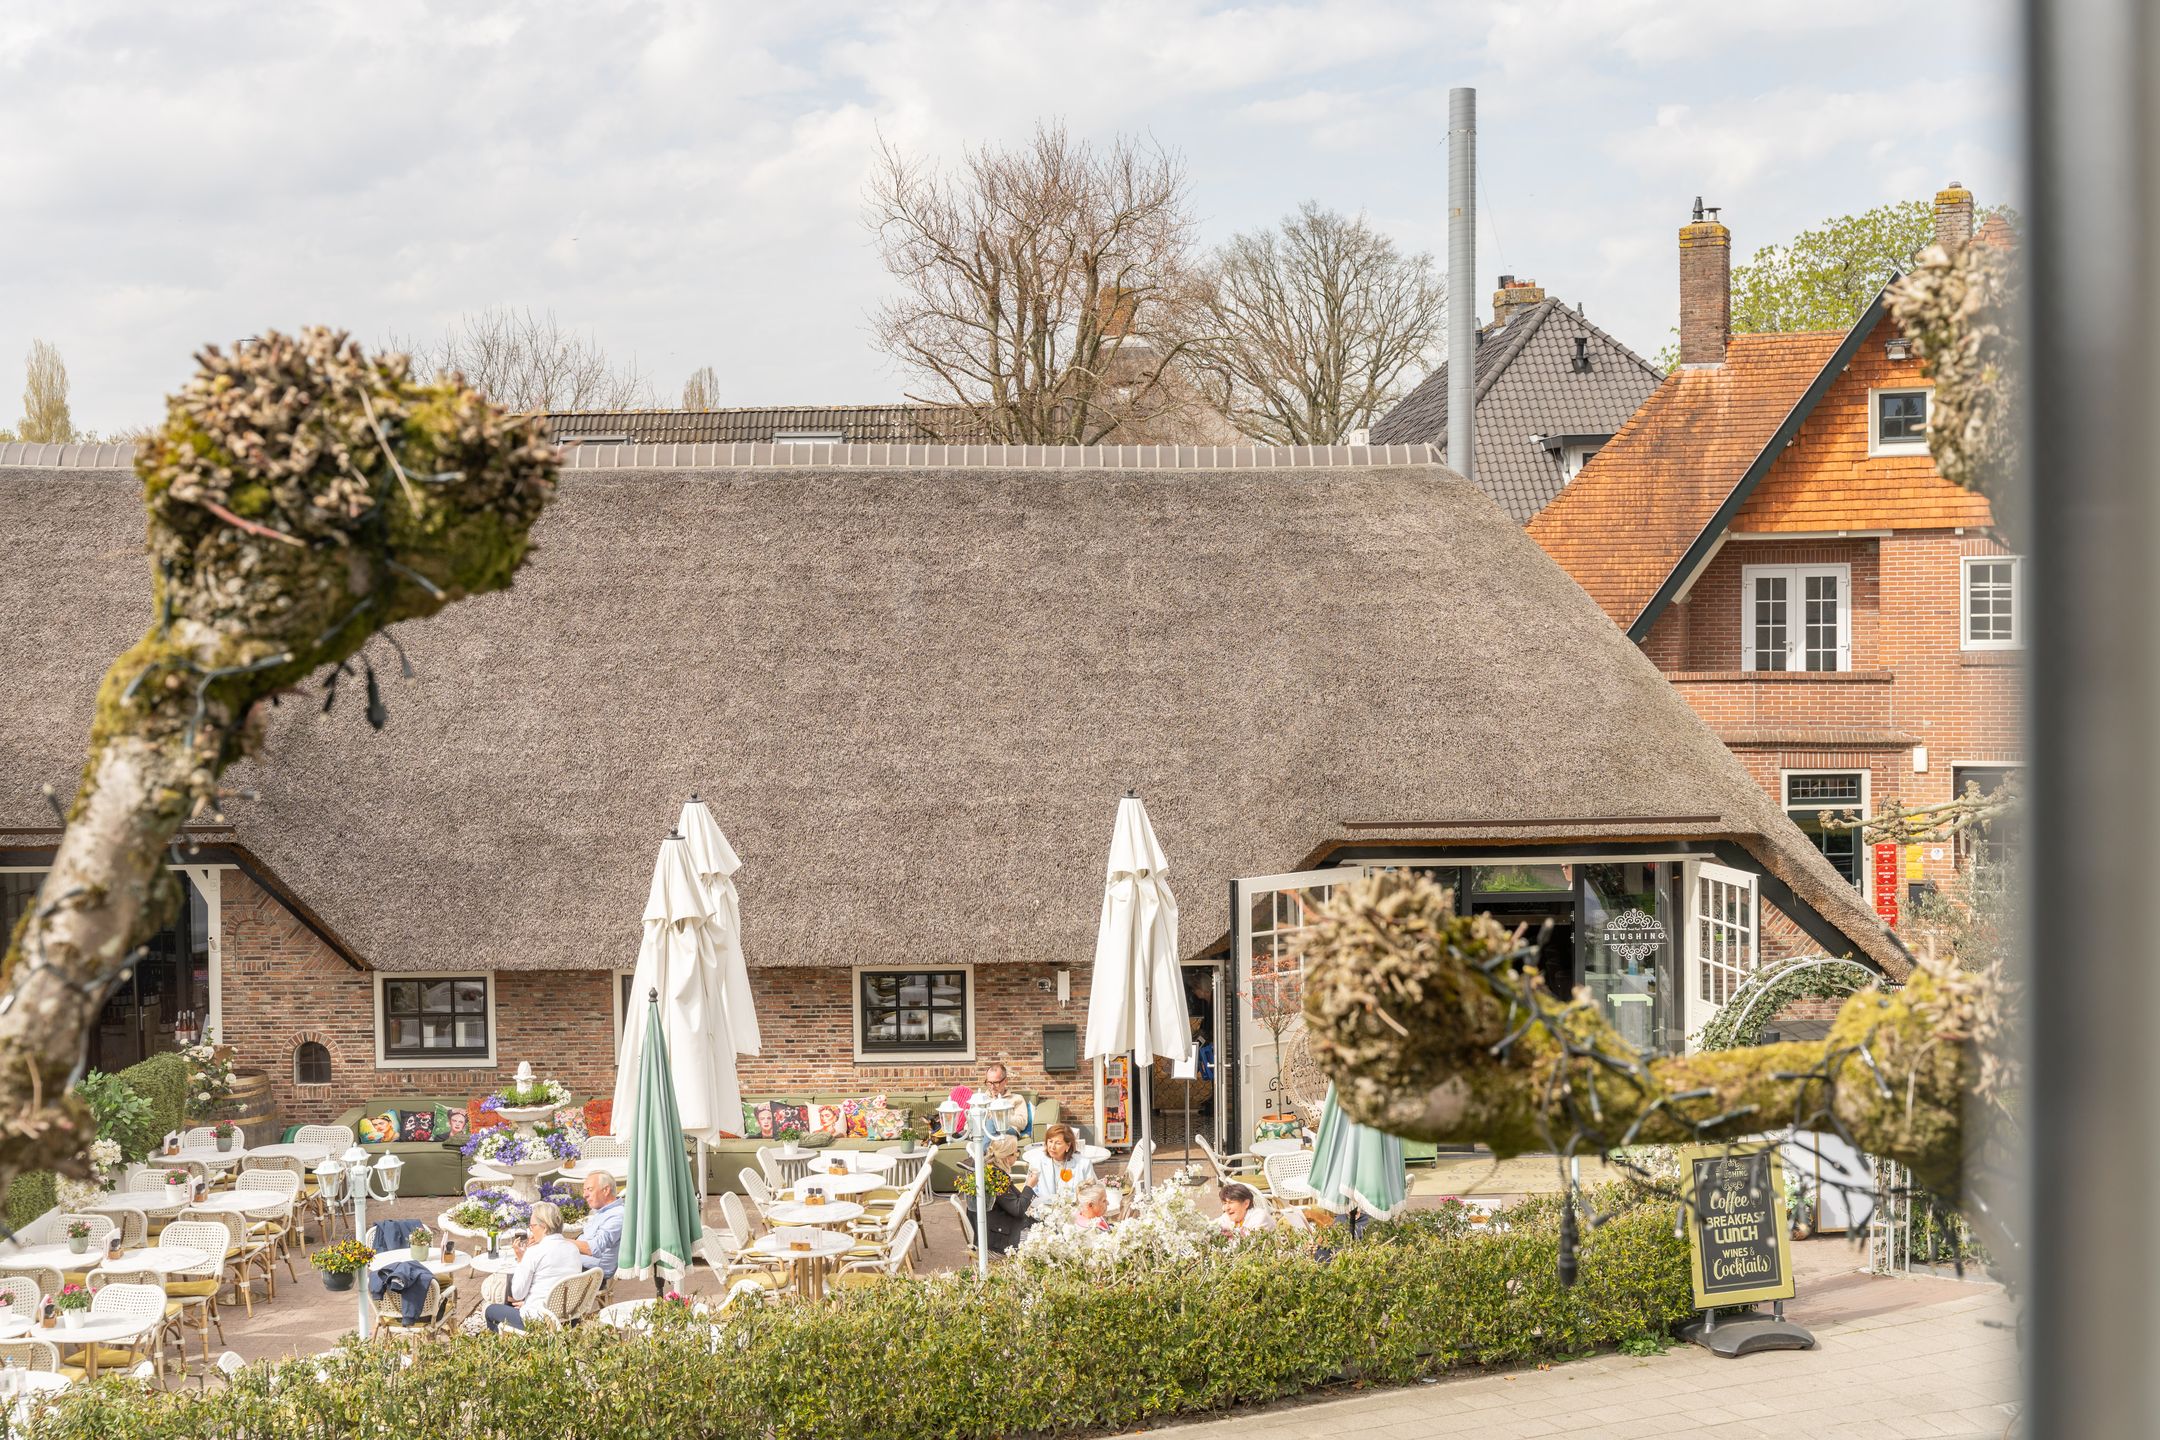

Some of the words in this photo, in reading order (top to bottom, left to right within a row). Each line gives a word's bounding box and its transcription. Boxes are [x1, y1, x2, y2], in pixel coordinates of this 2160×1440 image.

[1604, 932, 1666, 941] BLUSHING
[1709, 1190, 1750, 1214] Coffee
[1706, 1211, 1766, 1228] BREAKFAST
[1714, 1225, 1759, 1244] LUNCH
[1722, 1247, 1749, 1258] WINES
[1749, 1246, 1755, 1256] &
[1712, 1254, 1772, 1280] Cocktails
